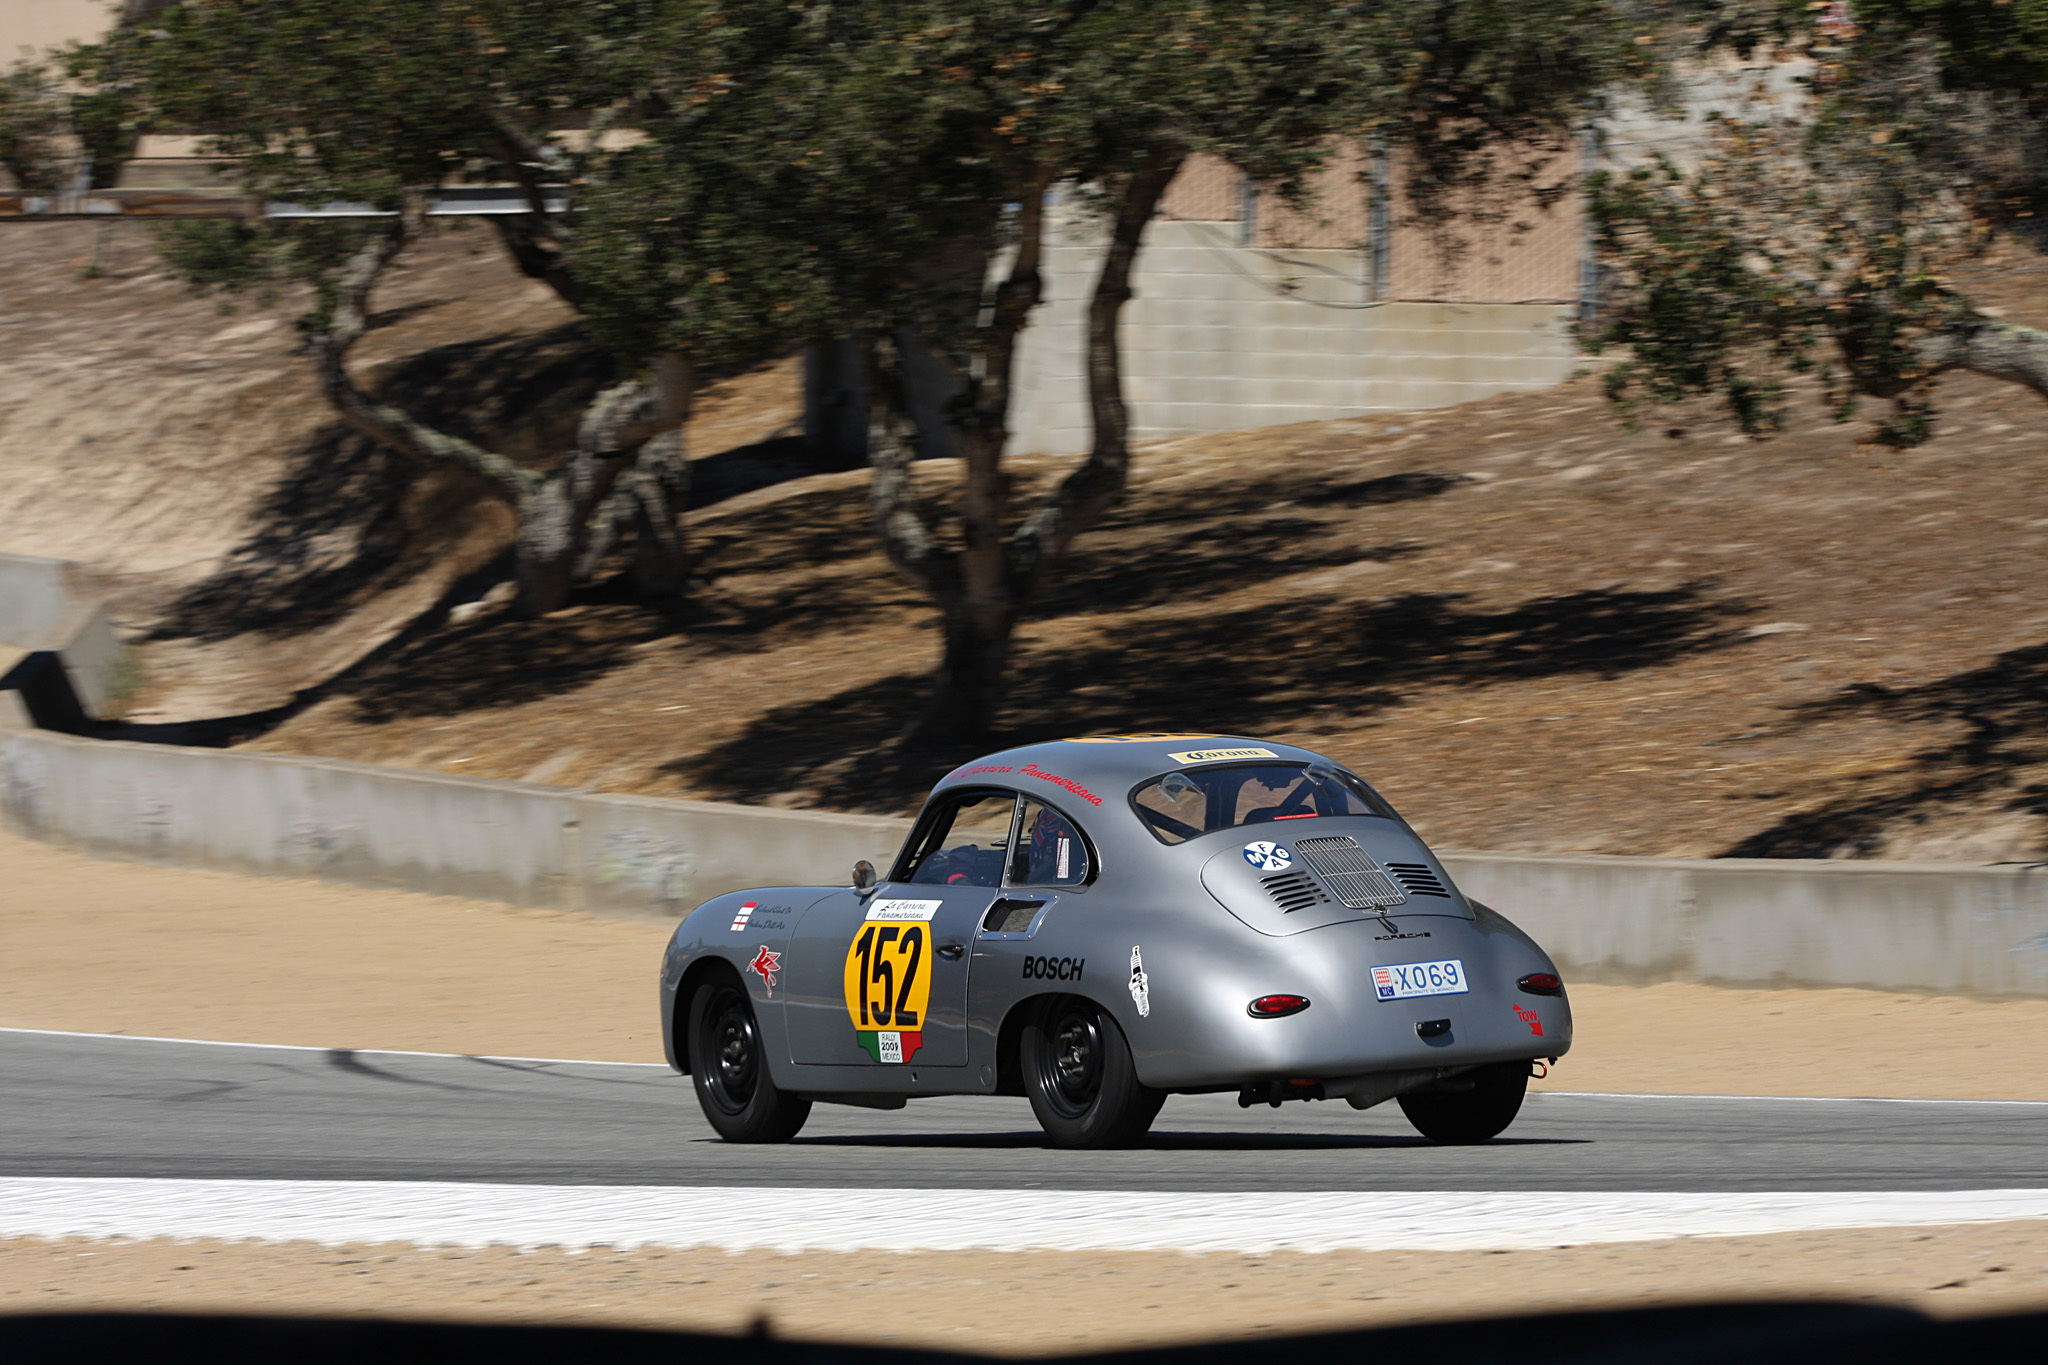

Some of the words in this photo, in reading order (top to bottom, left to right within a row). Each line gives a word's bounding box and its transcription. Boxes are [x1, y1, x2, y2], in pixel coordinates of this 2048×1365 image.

[1186, 749, 1260, 760] Corona
[960, 763, 1014, 778] Carrera
[1016, 764, 1103, 806] Panamericana
[1373, 932, 1432, 941] PORSCHE
[1022, 955, 1085, 981] BOSCH
[855, 926, 923, 1026] 152
[1396, 963, 1459, 990] X069
[1381, 987, 1393, 996] MC
[1516, 1010, 1538, 1022] TOW
[881, 1033, 896, 1041] RALLY
[881, 1042, 899, 1051] 2009
[881, 1053, 901, 1061] MEXICO
